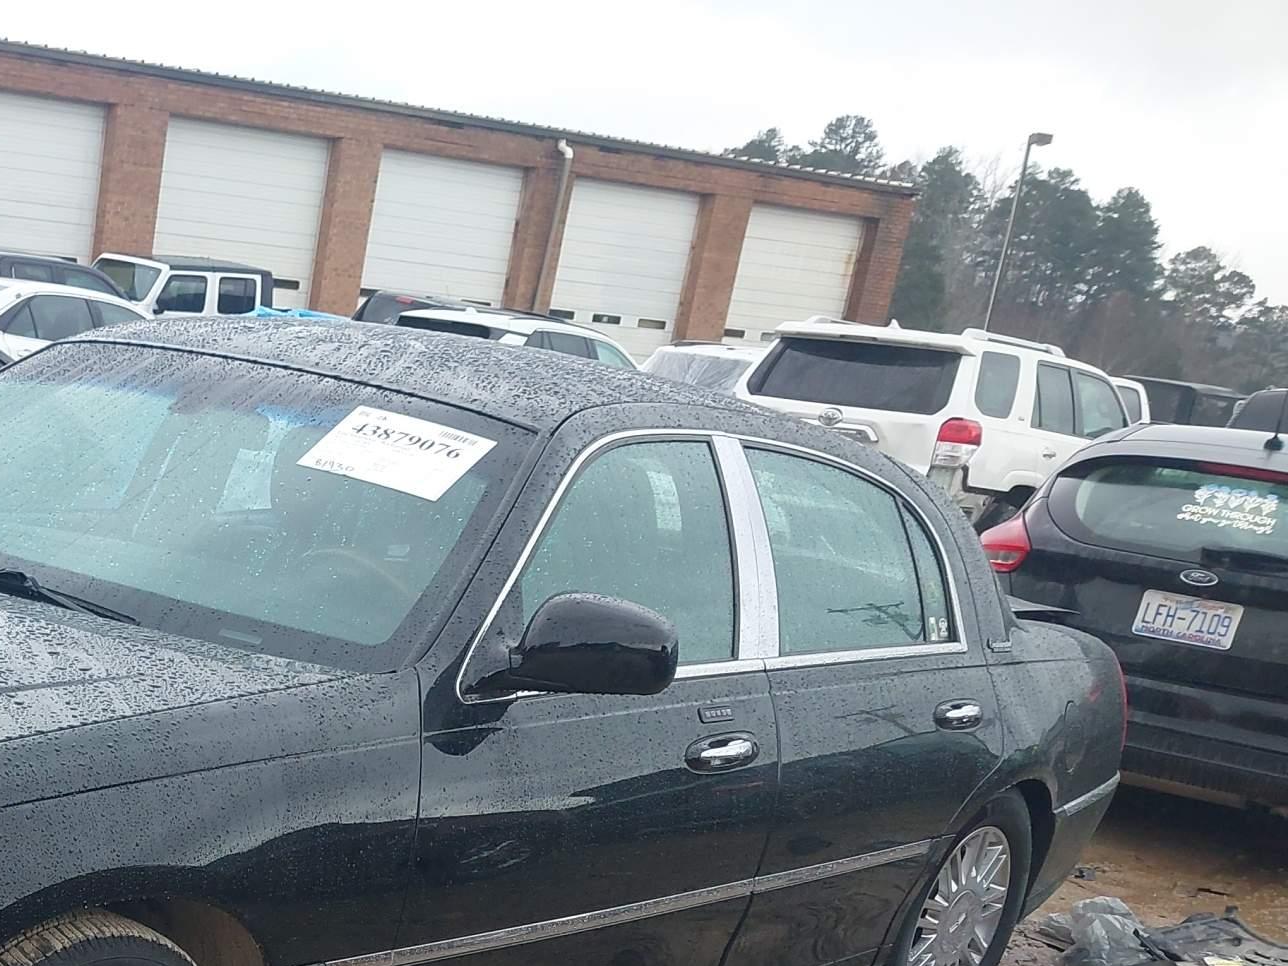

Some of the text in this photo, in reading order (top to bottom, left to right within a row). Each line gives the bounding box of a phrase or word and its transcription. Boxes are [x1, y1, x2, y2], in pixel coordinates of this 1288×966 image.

[352, 422, 461, 459] 43879076
[1181, 504, 1277, 526] GROW THROUGH
[1141, 602, 1232, 638] LFH-7109
[1141, 624, 1222, 646] NORTH CAROLINA
